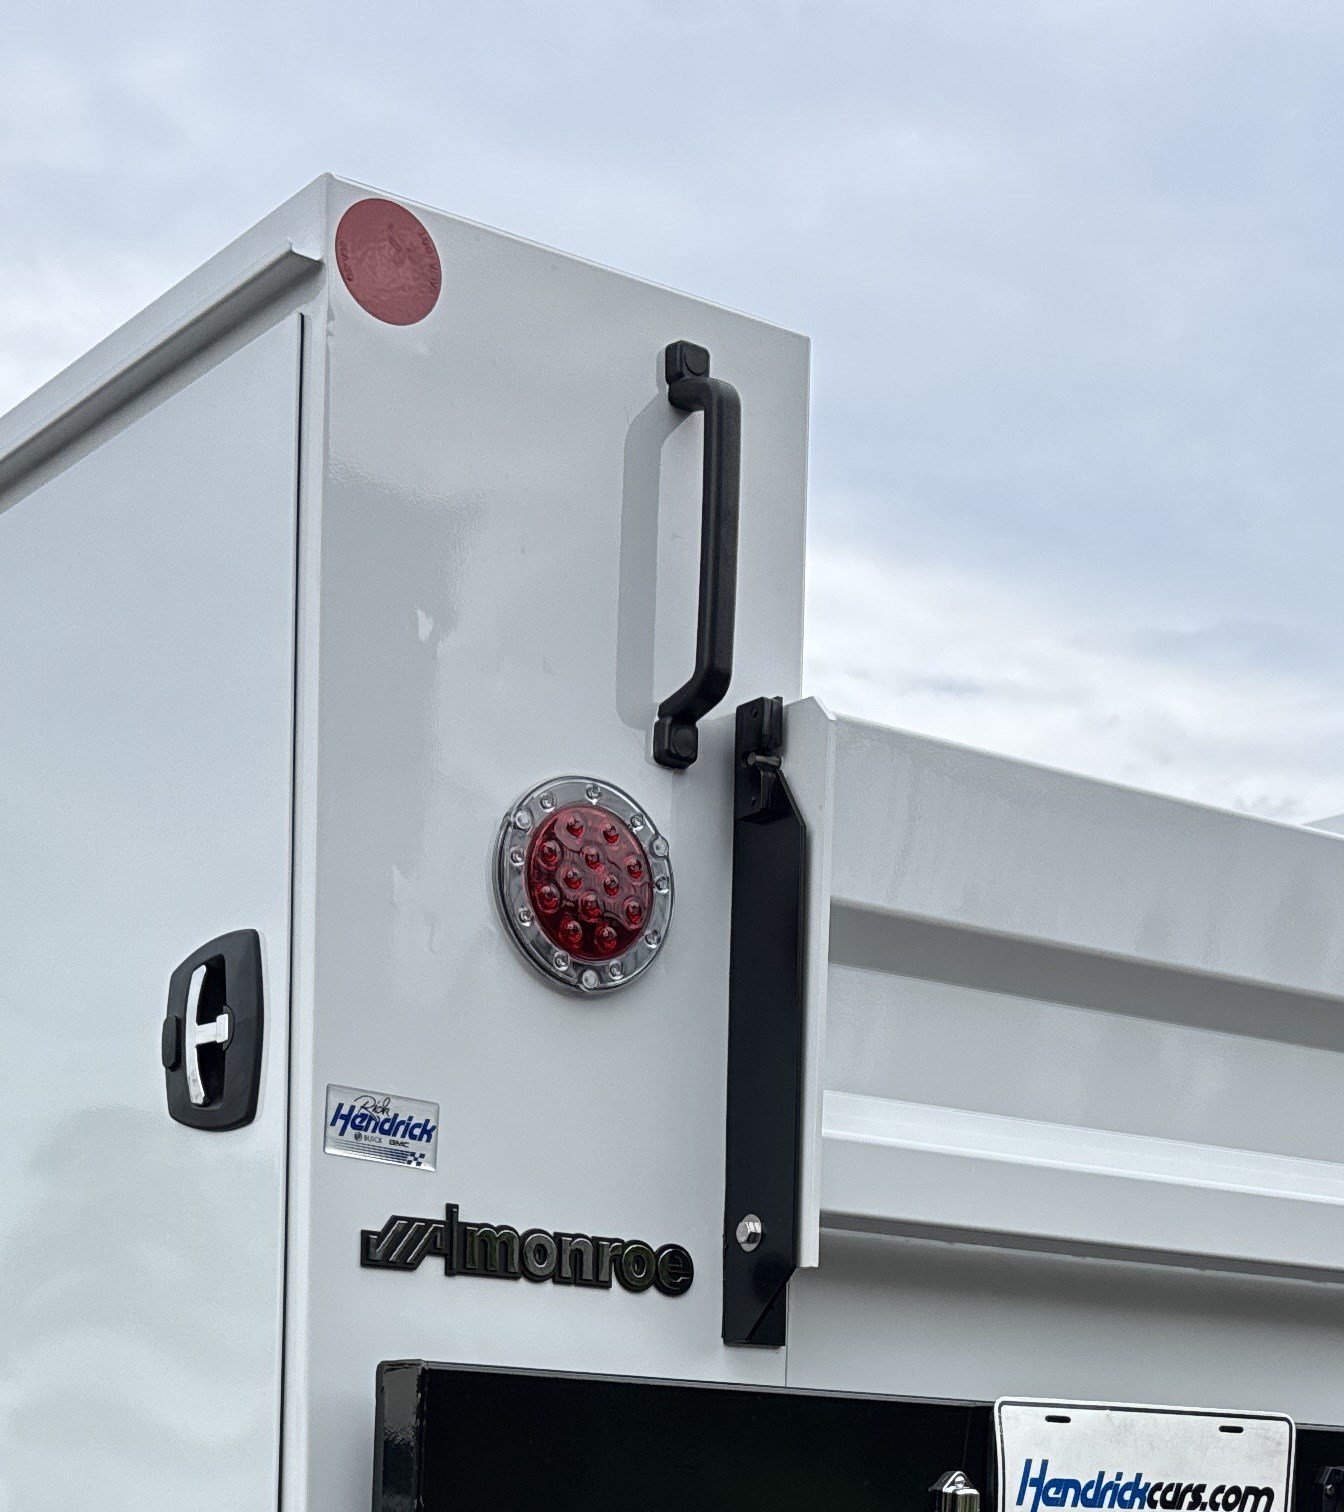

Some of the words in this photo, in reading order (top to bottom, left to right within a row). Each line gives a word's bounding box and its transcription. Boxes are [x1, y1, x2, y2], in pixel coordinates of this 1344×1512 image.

[330, 1103, 436, 1143] Hendrick
[389, 1139, 410, 1148] GMC
[463, 1222, 695, 1297] monroe
